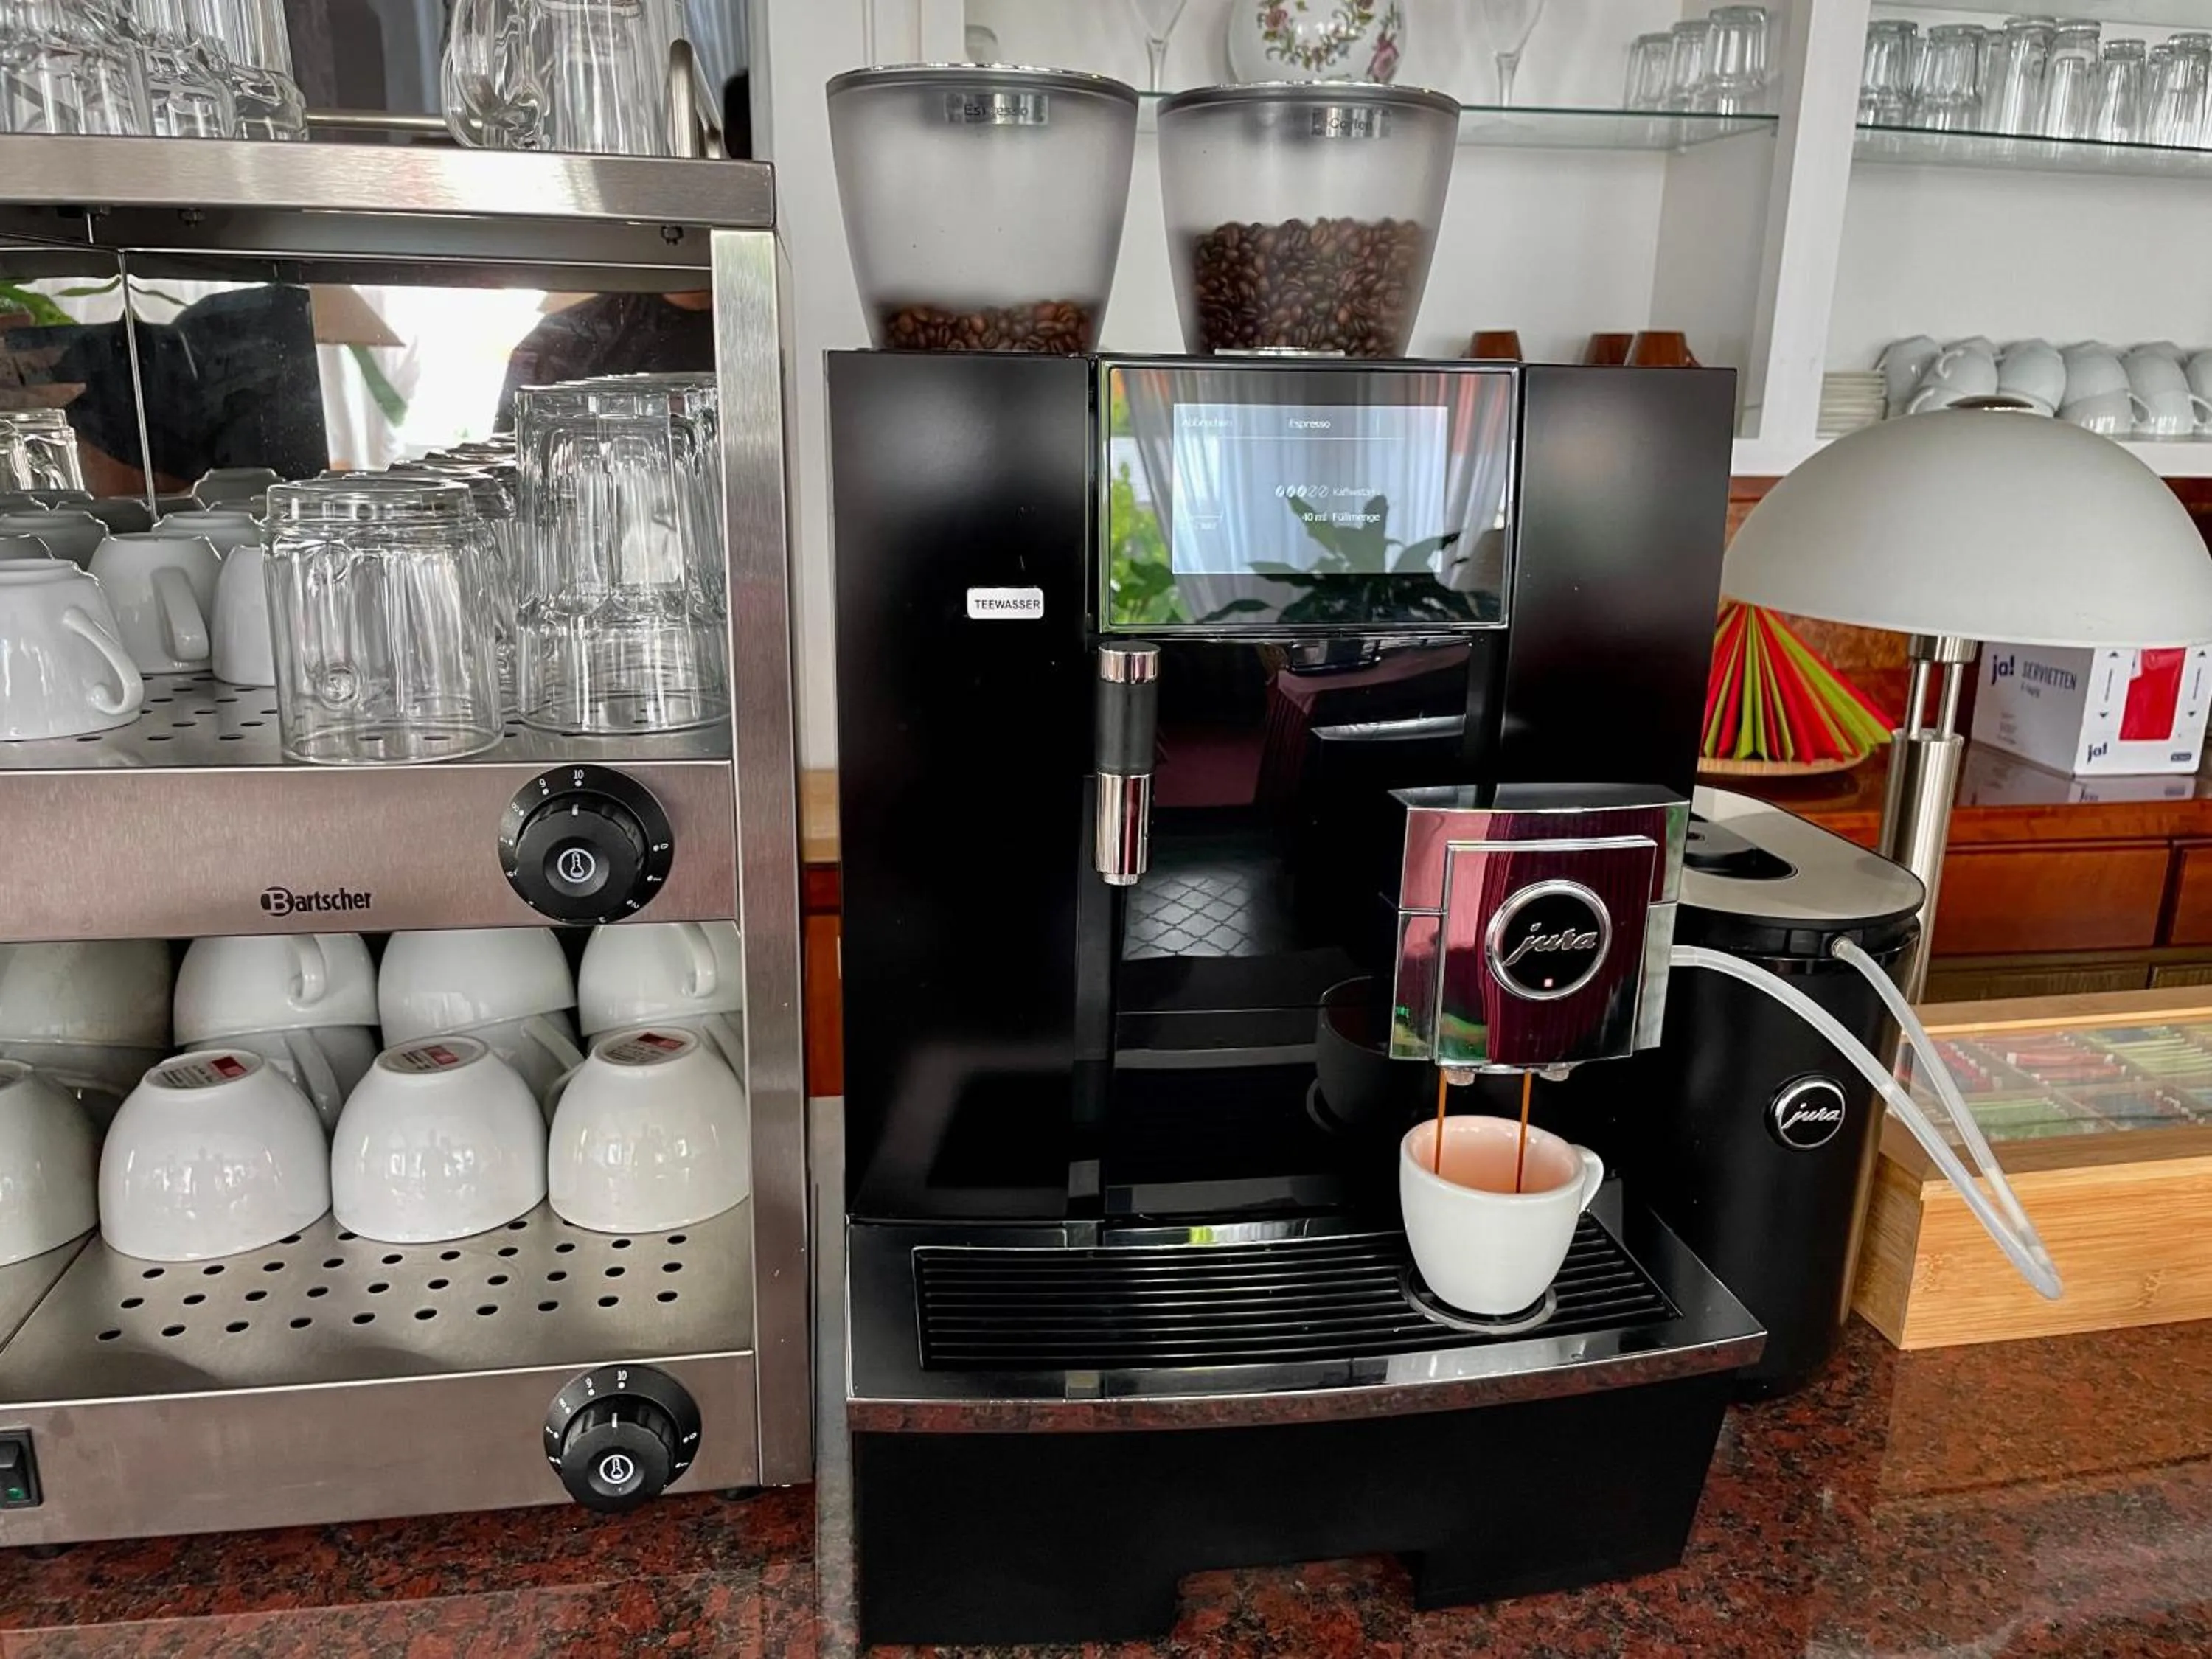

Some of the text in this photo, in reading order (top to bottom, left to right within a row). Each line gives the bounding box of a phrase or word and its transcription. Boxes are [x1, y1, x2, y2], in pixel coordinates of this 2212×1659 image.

[964, 104, 1028, 116] Esesso
[1288, 418, 1331, 429] Espresso
[974, 599, 1041, 610] TEEWASSER
[1992, 653, 2014, 686] ja!
[2021, 661, 2077, 691] SERVIETTEN
[2087, 741, 2108, 764] ja!
[573, 769, 585, 779] 10
[539, 778, 546, 788] 9
[260, 886, 372, 917] Bartscher
[1501, 922, 1599, 967] jura
[1781, 1102, 1842, 1129] jura
[617, 1369, 627, 1381] 10
